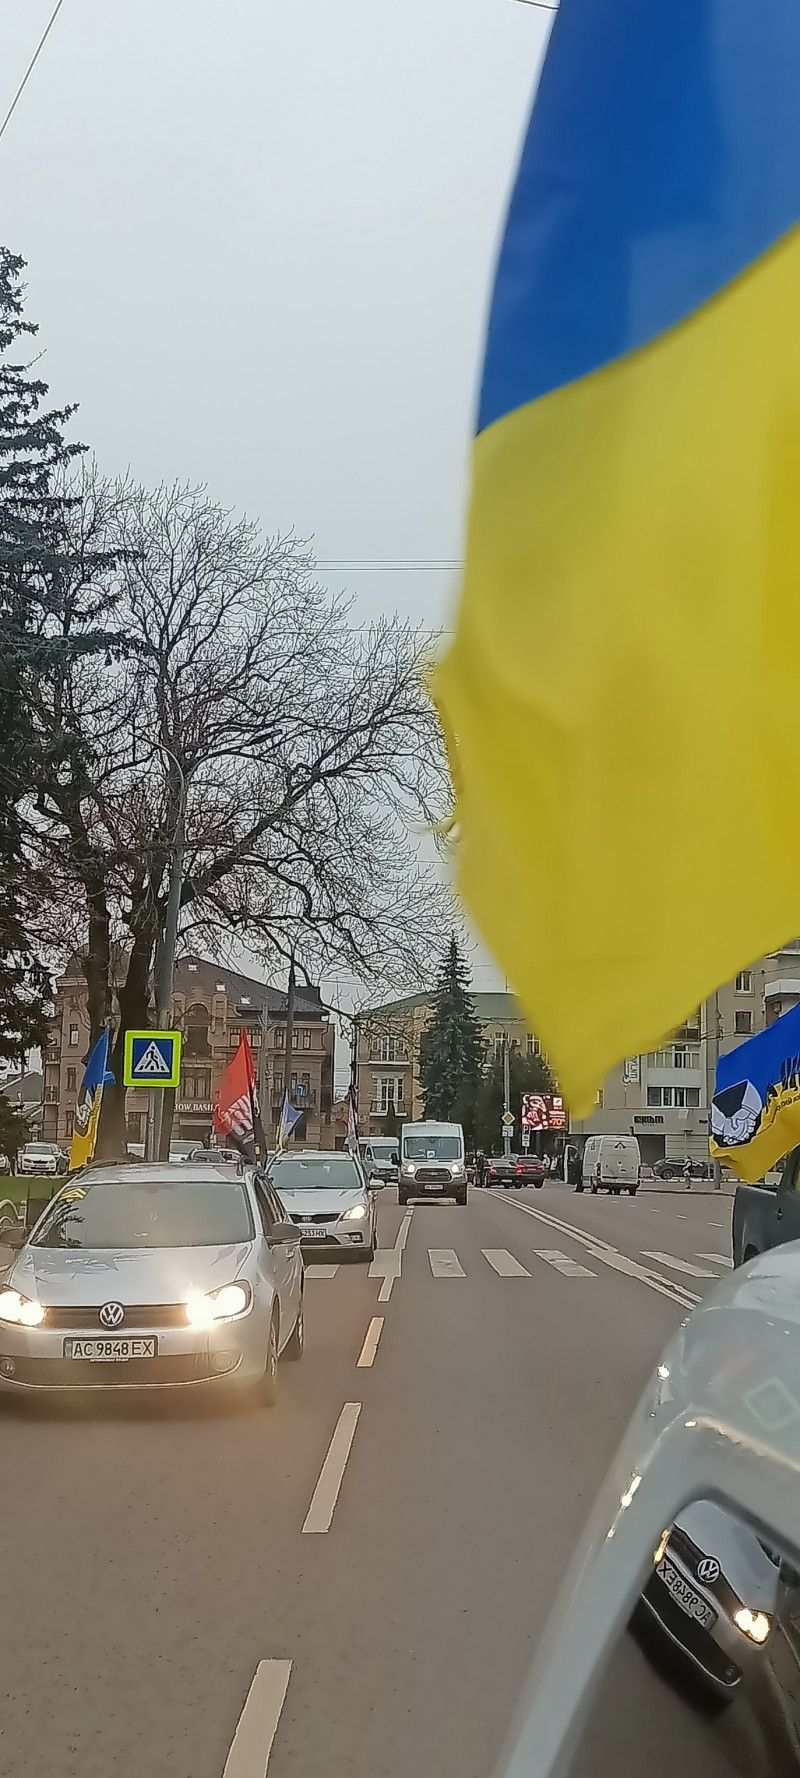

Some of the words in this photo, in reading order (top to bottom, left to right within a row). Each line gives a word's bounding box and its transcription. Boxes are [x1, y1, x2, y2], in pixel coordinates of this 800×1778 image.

[74, 1342, 93, 1357] AC
[96, 1341, 129, 1356] 9848
[132, 1341, 153, 1355] EX
